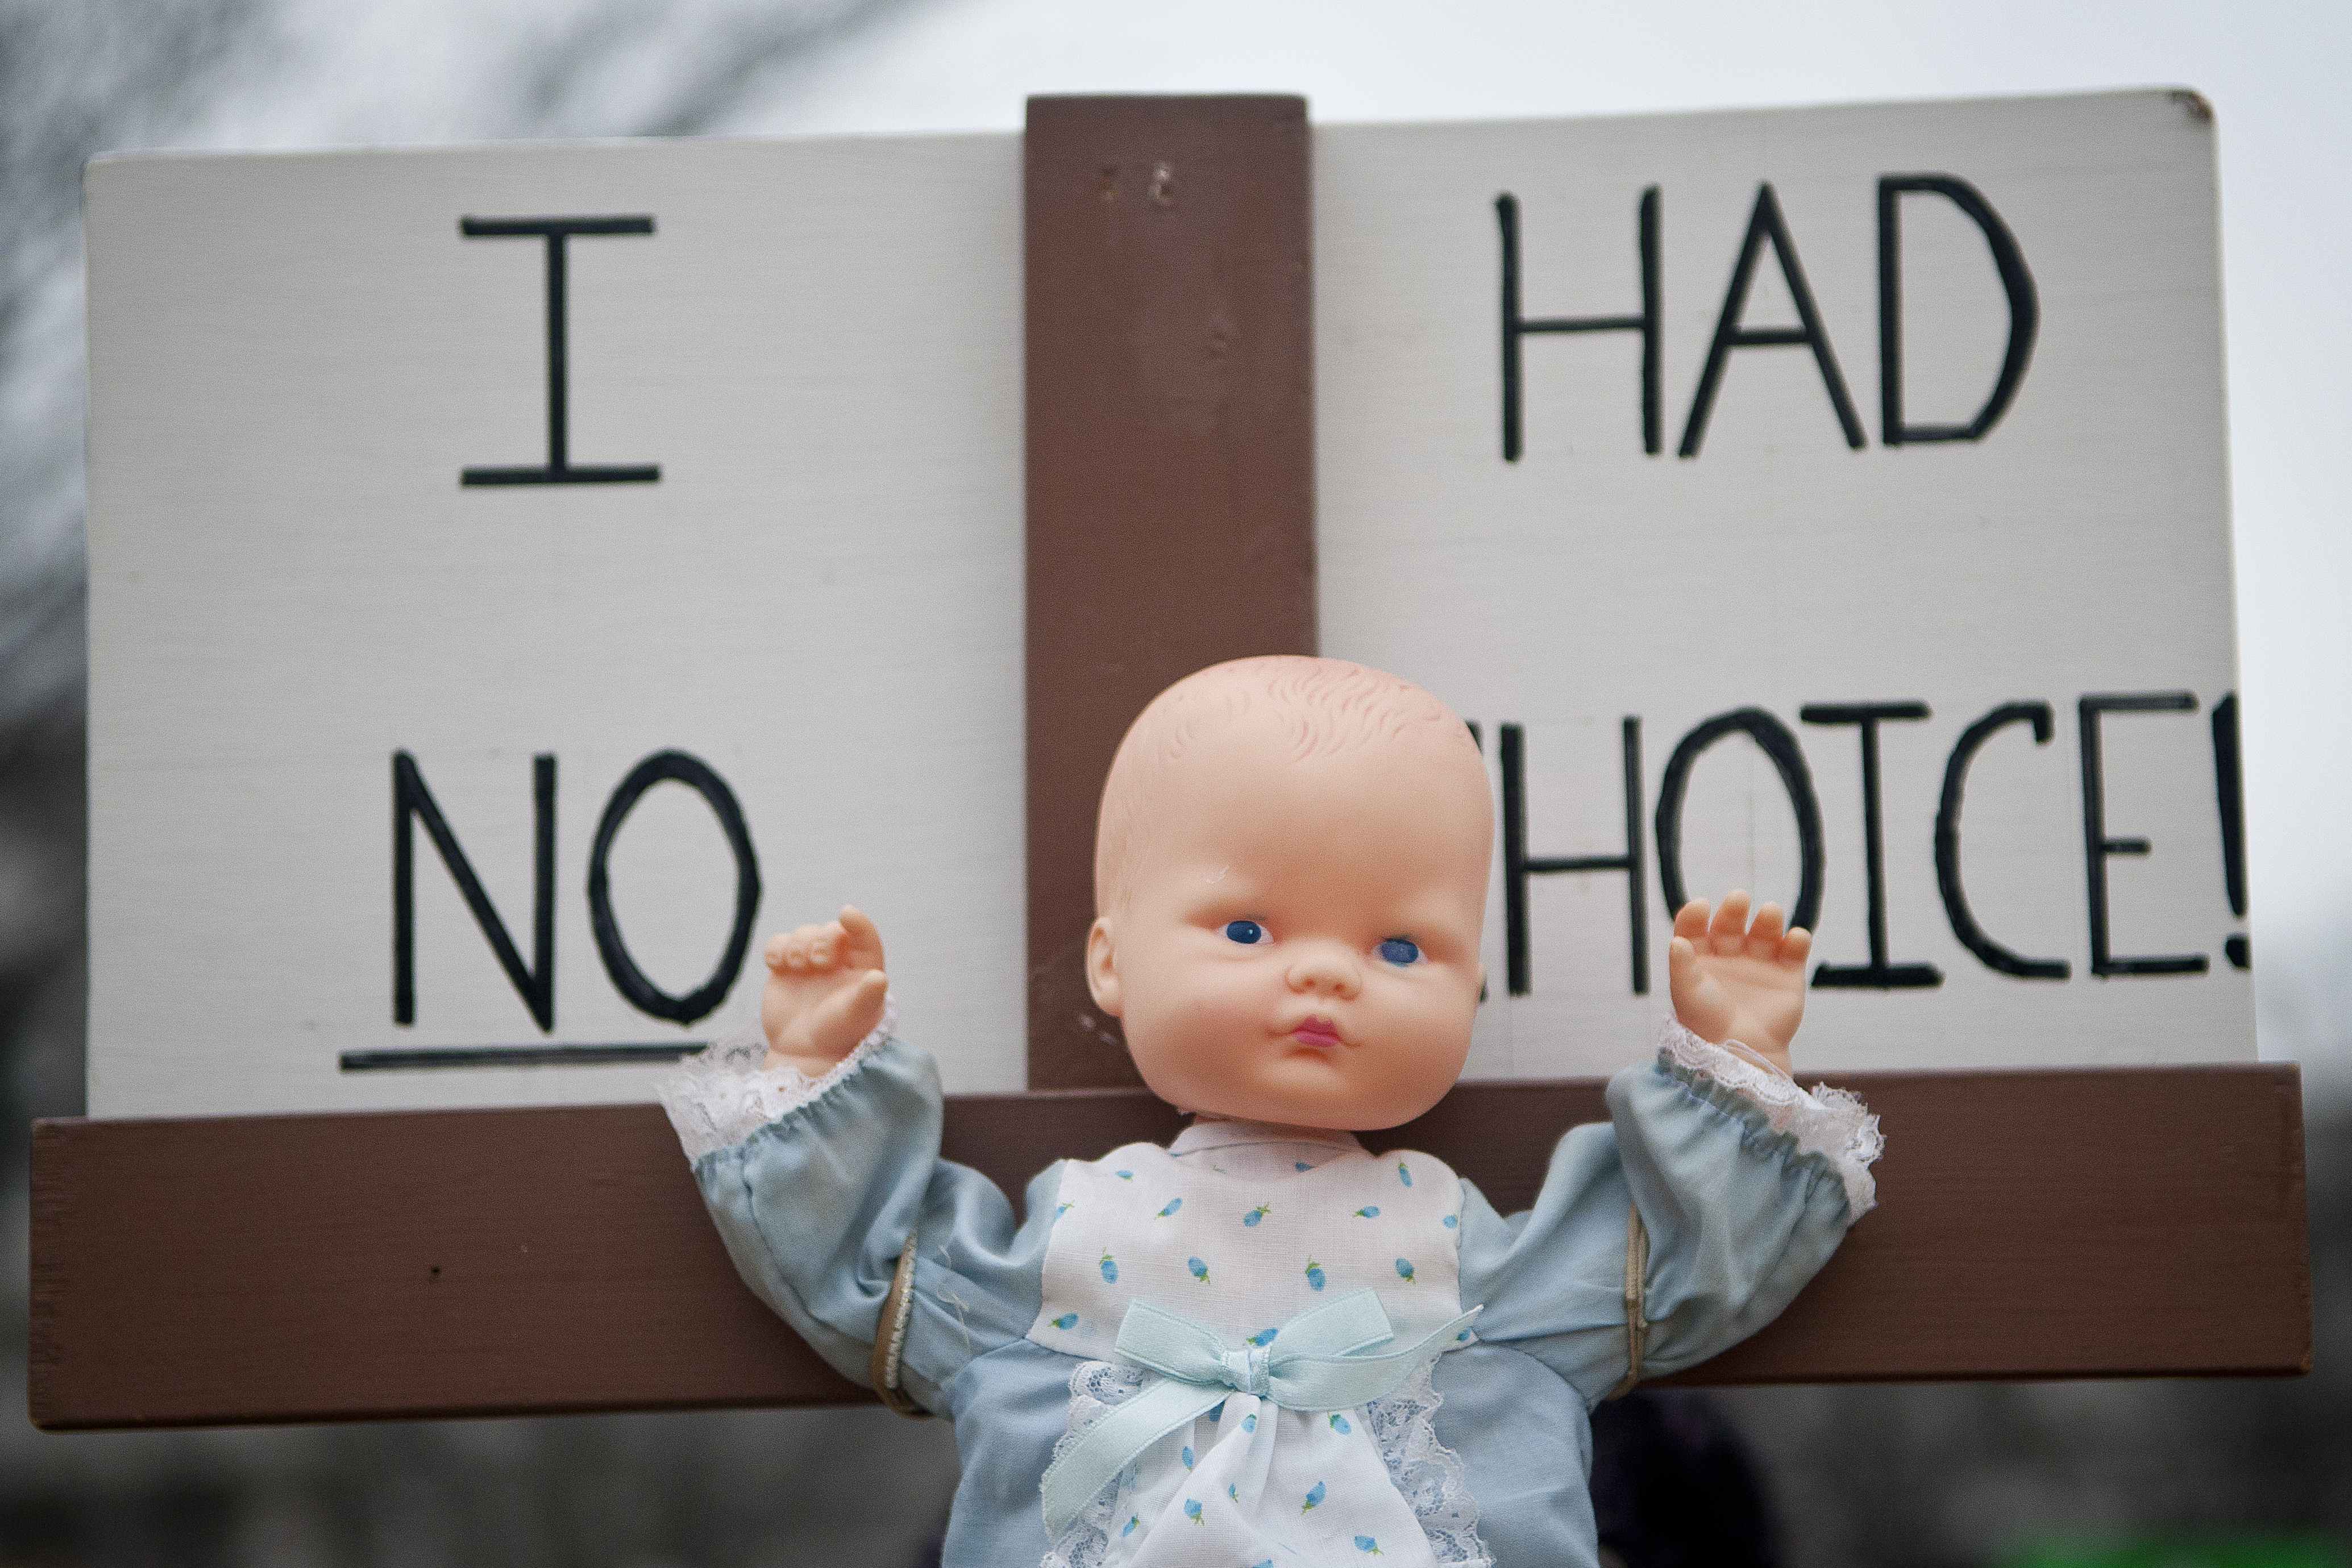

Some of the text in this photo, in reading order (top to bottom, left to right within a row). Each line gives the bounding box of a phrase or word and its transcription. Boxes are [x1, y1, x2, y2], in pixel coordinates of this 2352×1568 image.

[458, 172, 2041, 489] I HAD
[391, 691, 2252, 1034] NO HOICE!
